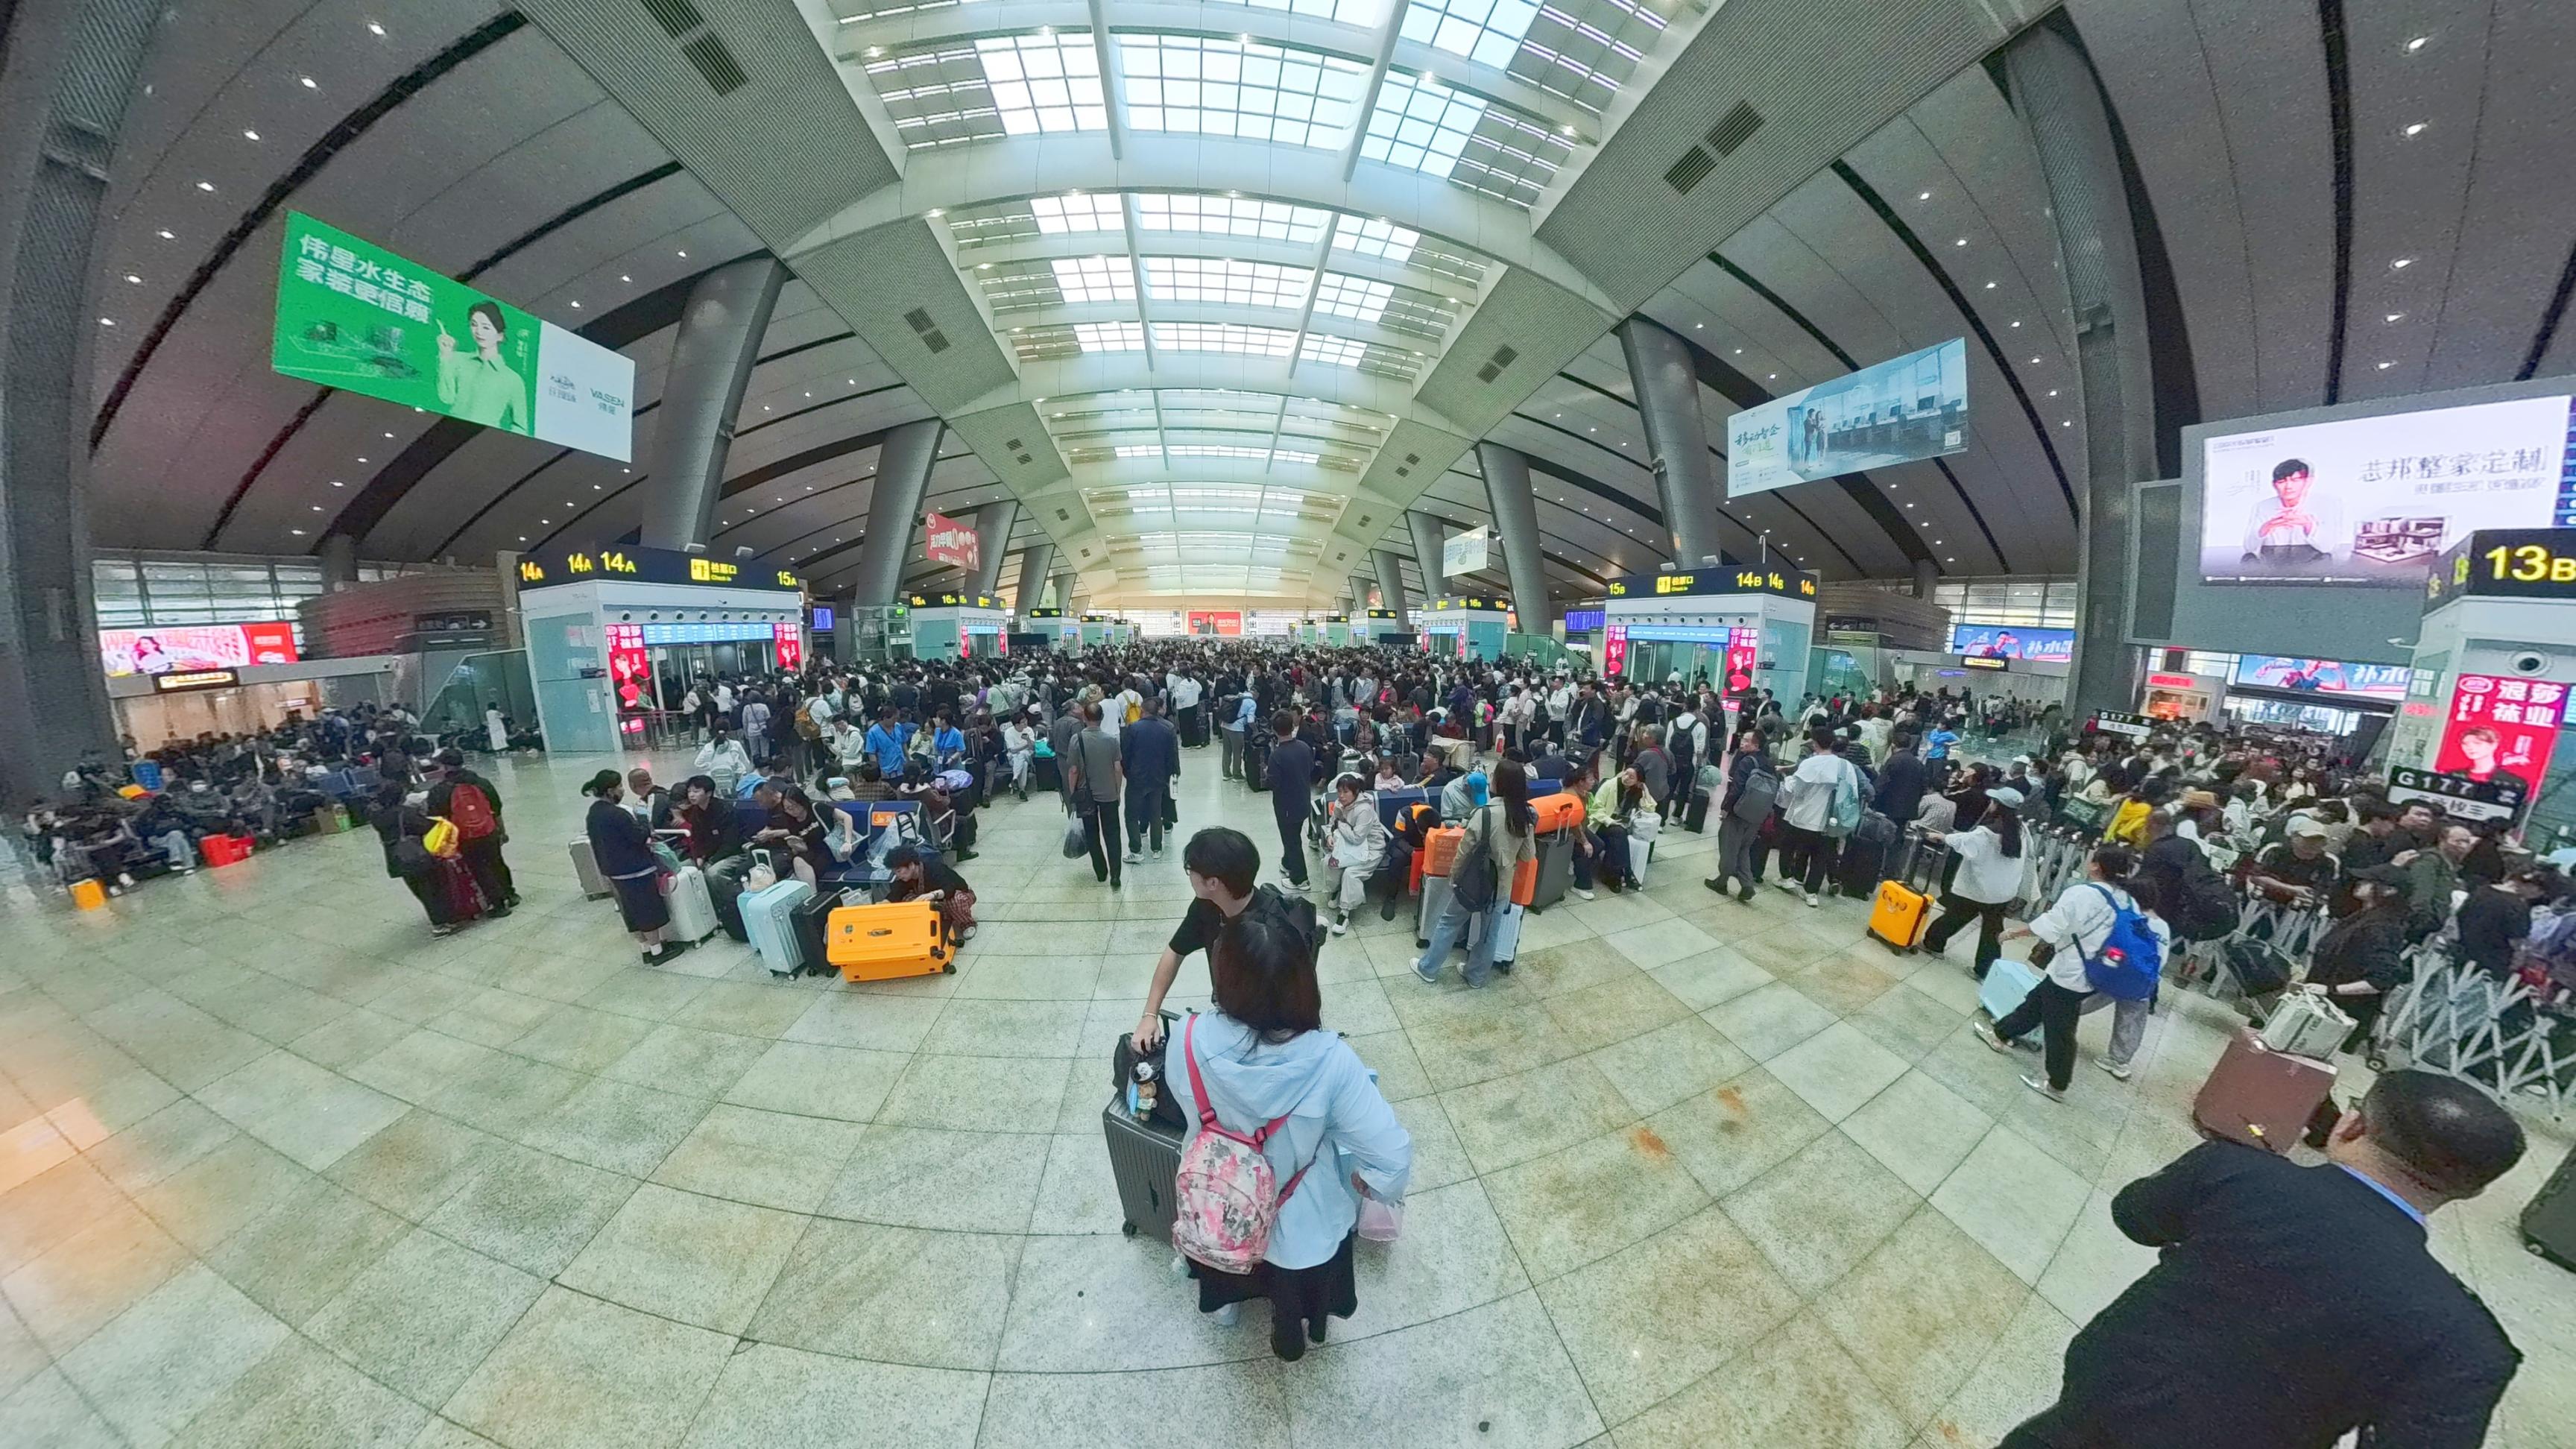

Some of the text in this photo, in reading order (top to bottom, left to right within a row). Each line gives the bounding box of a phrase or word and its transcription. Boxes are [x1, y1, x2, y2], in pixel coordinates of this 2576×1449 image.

[299, 234, 434, 303] 伟星水生态
[520, 561, 543, 581] 14A
[567, 552, 593, 573] 14A
[600, 551, 637, 573] 14A
[2484, 545, 2576, 581] 13B
[777, 571, 798, 586] 15A
[1737, 572, 1762, 587] 14B
[1768, 572, 1784, 590] 14B
[1801, 579, 1815, 595] 14B
[1609, 583, 1625, 595] 15B
[912, 596, 926, 605] 16A
[942, 595, 956, 604] 16A
[2496, 680, 2564, 704] 浪莎
[2492, 703, 2555, 727] 袜业
[2397, 771, 2474, 795] G177
